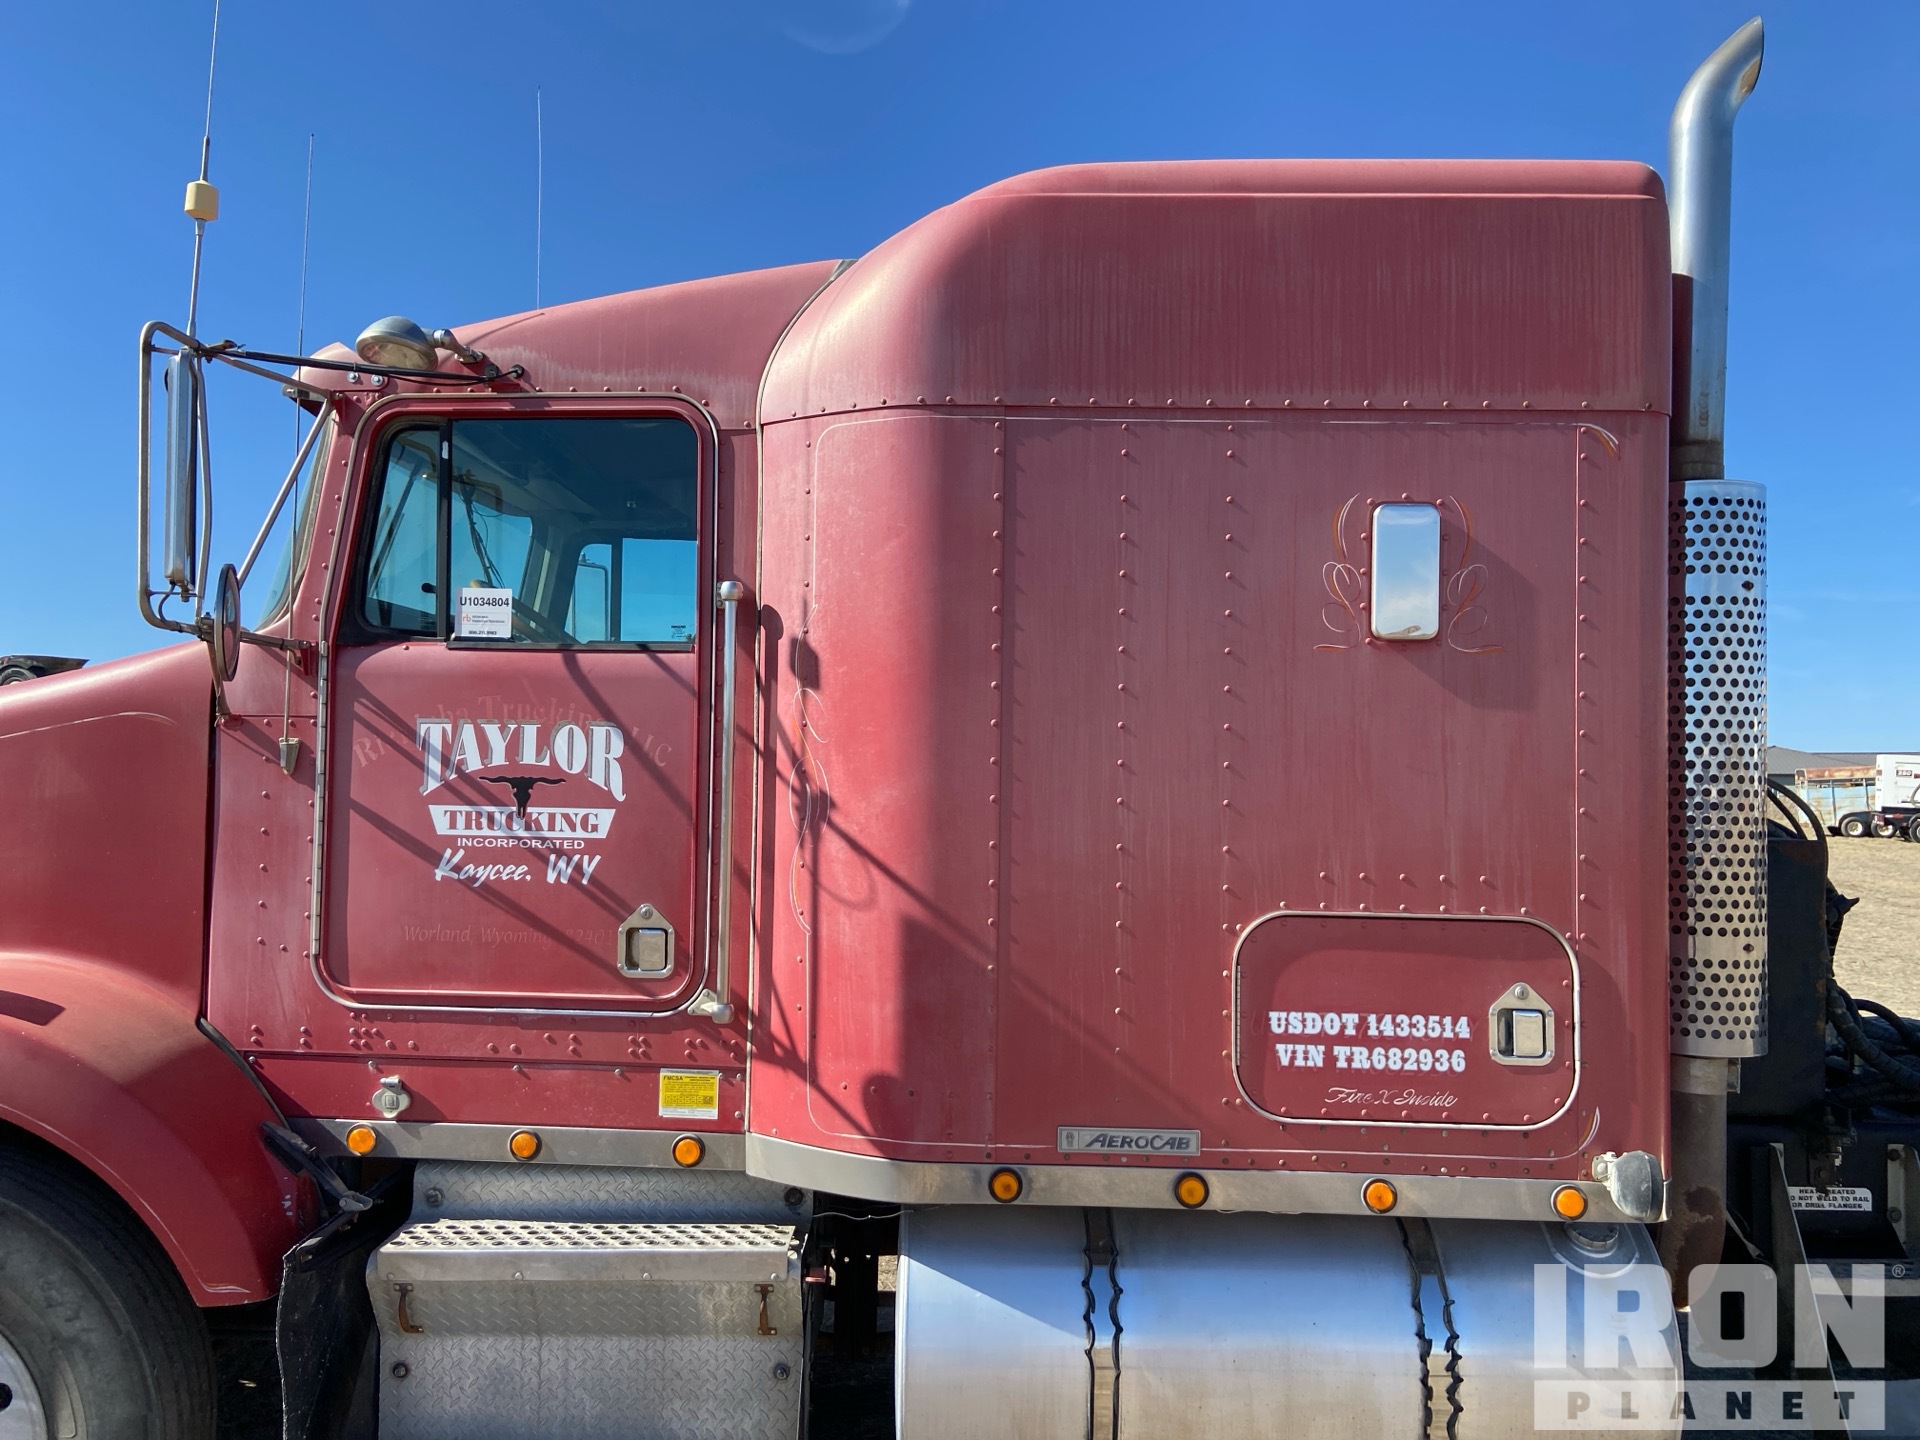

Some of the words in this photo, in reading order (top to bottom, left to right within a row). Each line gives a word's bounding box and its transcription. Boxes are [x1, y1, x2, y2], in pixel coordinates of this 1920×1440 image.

[460, 597, 510, 606] U1034804
[416, 718, 626, 802] TAYLOR
[444, 810, 600, 833] TRUCKING
[457, 837, 585, 849] INCORPORATED
[546, 853, 601, 885] WY
[1268, 1011, 1359, 1036] USDOT
[1367, 1013, 1470, 1039] 1433514
[1275, 1043, 1325, 1068] VIN
[1333, 1045, 1466, 1073] TR682936
